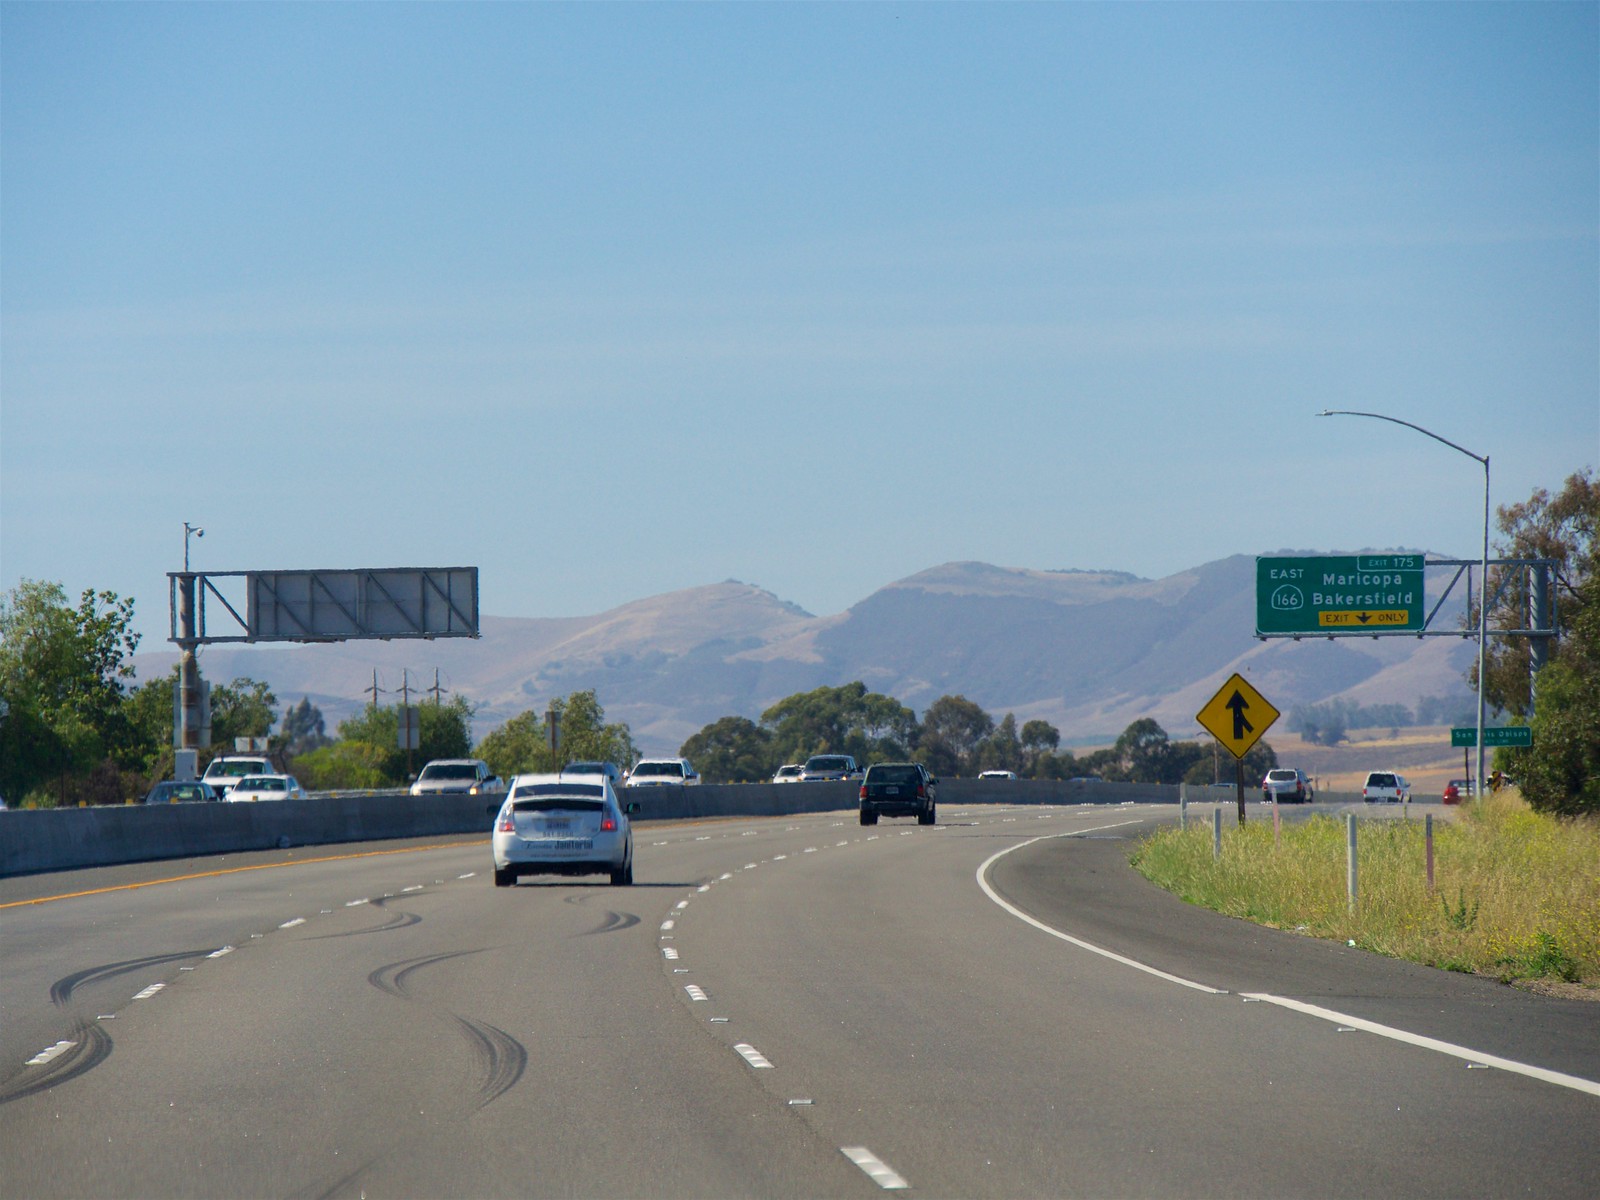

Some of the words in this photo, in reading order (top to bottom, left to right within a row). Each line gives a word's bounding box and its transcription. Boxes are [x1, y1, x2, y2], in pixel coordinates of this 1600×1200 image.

[1369, 559, 1387, 567] EXIT
[1393, 557, 1414, 567] 175
[1270, 569, 1304, 579] EAST
[1323, 572, 1402, 588] Maricopa
[1276, 594, 1298, 606] 166
[1312, 592, 1413, 605] Bakersfield
[1325, 614, 1349, 623] EXIT
[1378, 613, 1406, 622] ONLY
